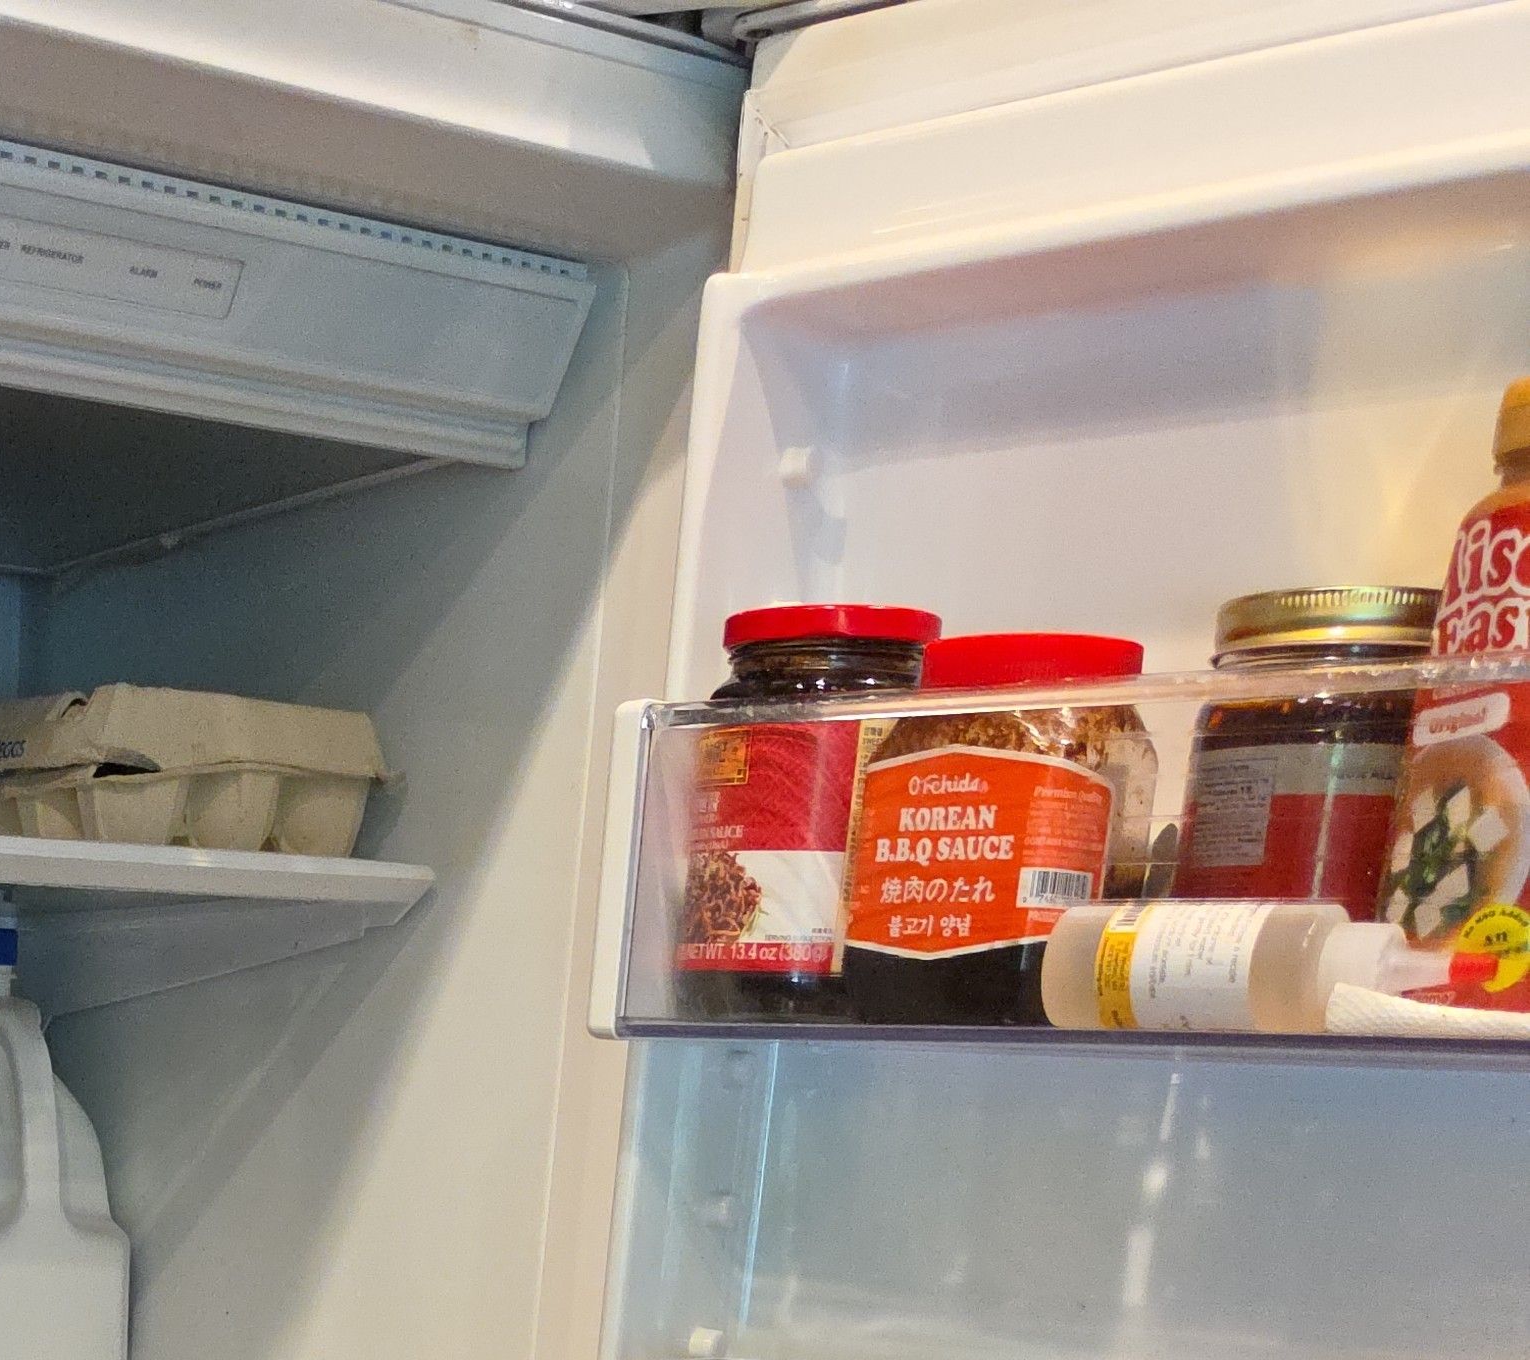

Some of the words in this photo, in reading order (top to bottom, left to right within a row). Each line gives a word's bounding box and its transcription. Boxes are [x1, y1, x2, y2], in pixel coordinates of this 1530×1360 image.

[898, 804, 998, 832] KOREAN
[874, 838, 933, 867] B.B.Q
[935, 834, 1016, 861] SAUCE
[880, 876, 997, 904] 焼肉のたれ
[887, 914, 935, 938] 불고기
[939, 913, 972, 937] 양념
[730, 944, 758, 960] 13.4
[759, 947, 777, 961] oz
